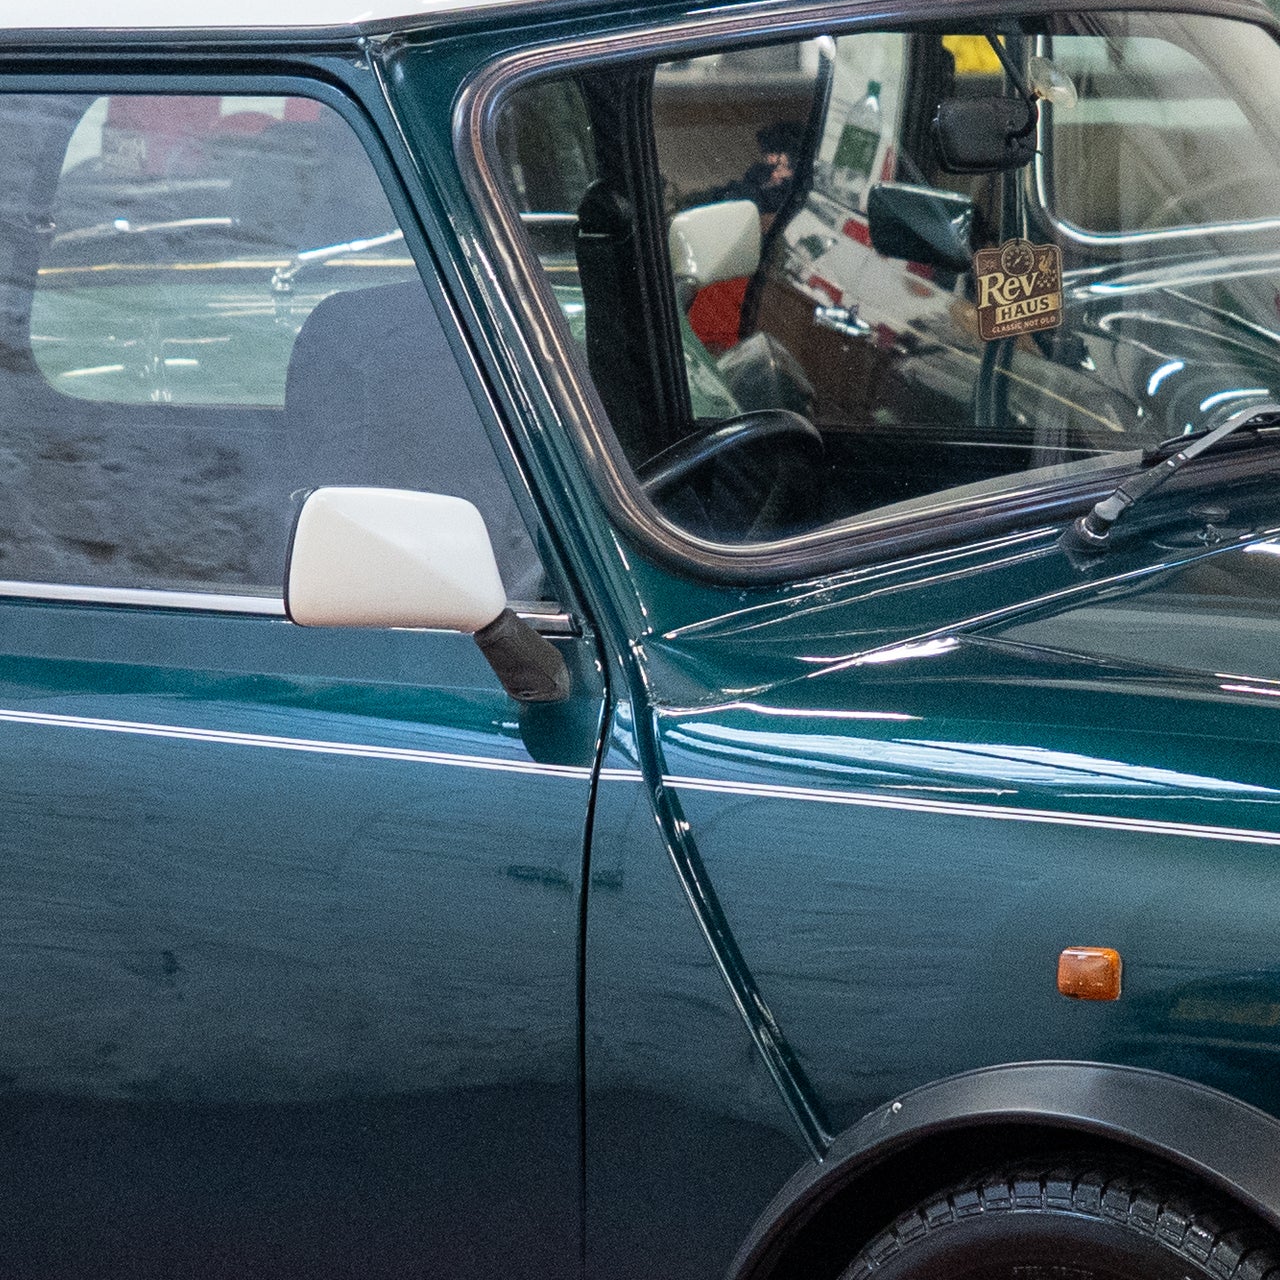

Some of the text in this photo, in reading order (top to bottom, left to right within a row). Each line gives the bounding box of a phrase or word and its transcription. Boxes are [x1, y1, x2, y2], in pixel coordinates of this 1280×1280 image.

[977, 272, 1038, 310] Rev
[1001, 297, 1050, 321] HAUS
[991, 315, 1056, 334] CLASSIC NOT OLD
